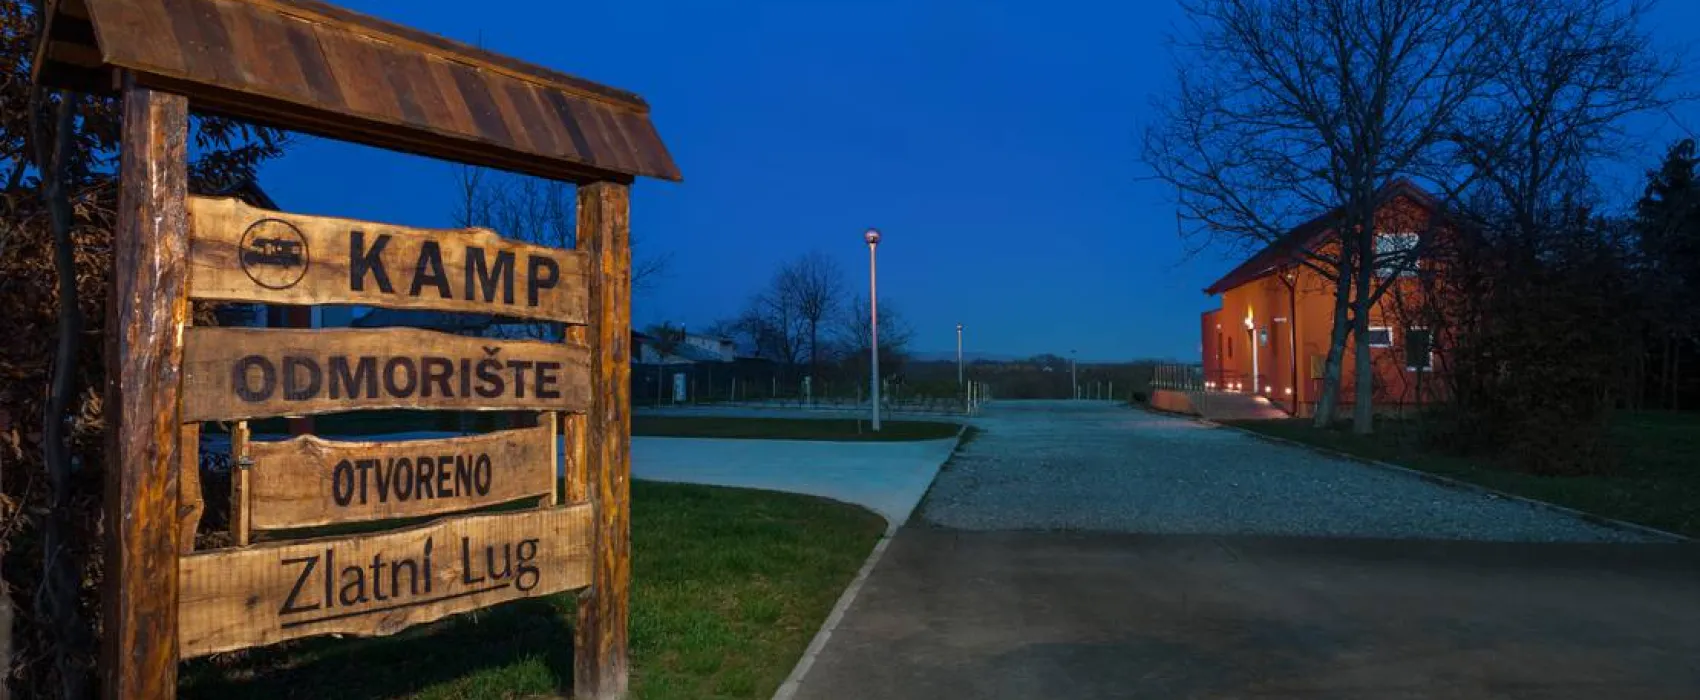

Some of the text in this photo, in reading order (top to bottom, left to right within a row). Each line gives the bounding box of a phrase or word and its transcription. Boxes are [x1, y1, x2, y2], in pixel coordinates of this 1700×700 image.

[349, 230, 560, 307] KAMP
[233, 346, 561, 402] ODMORIŠTE
[333, 453, 492, 507] OTVORENO
[462, 536, 540, 591] Lug
